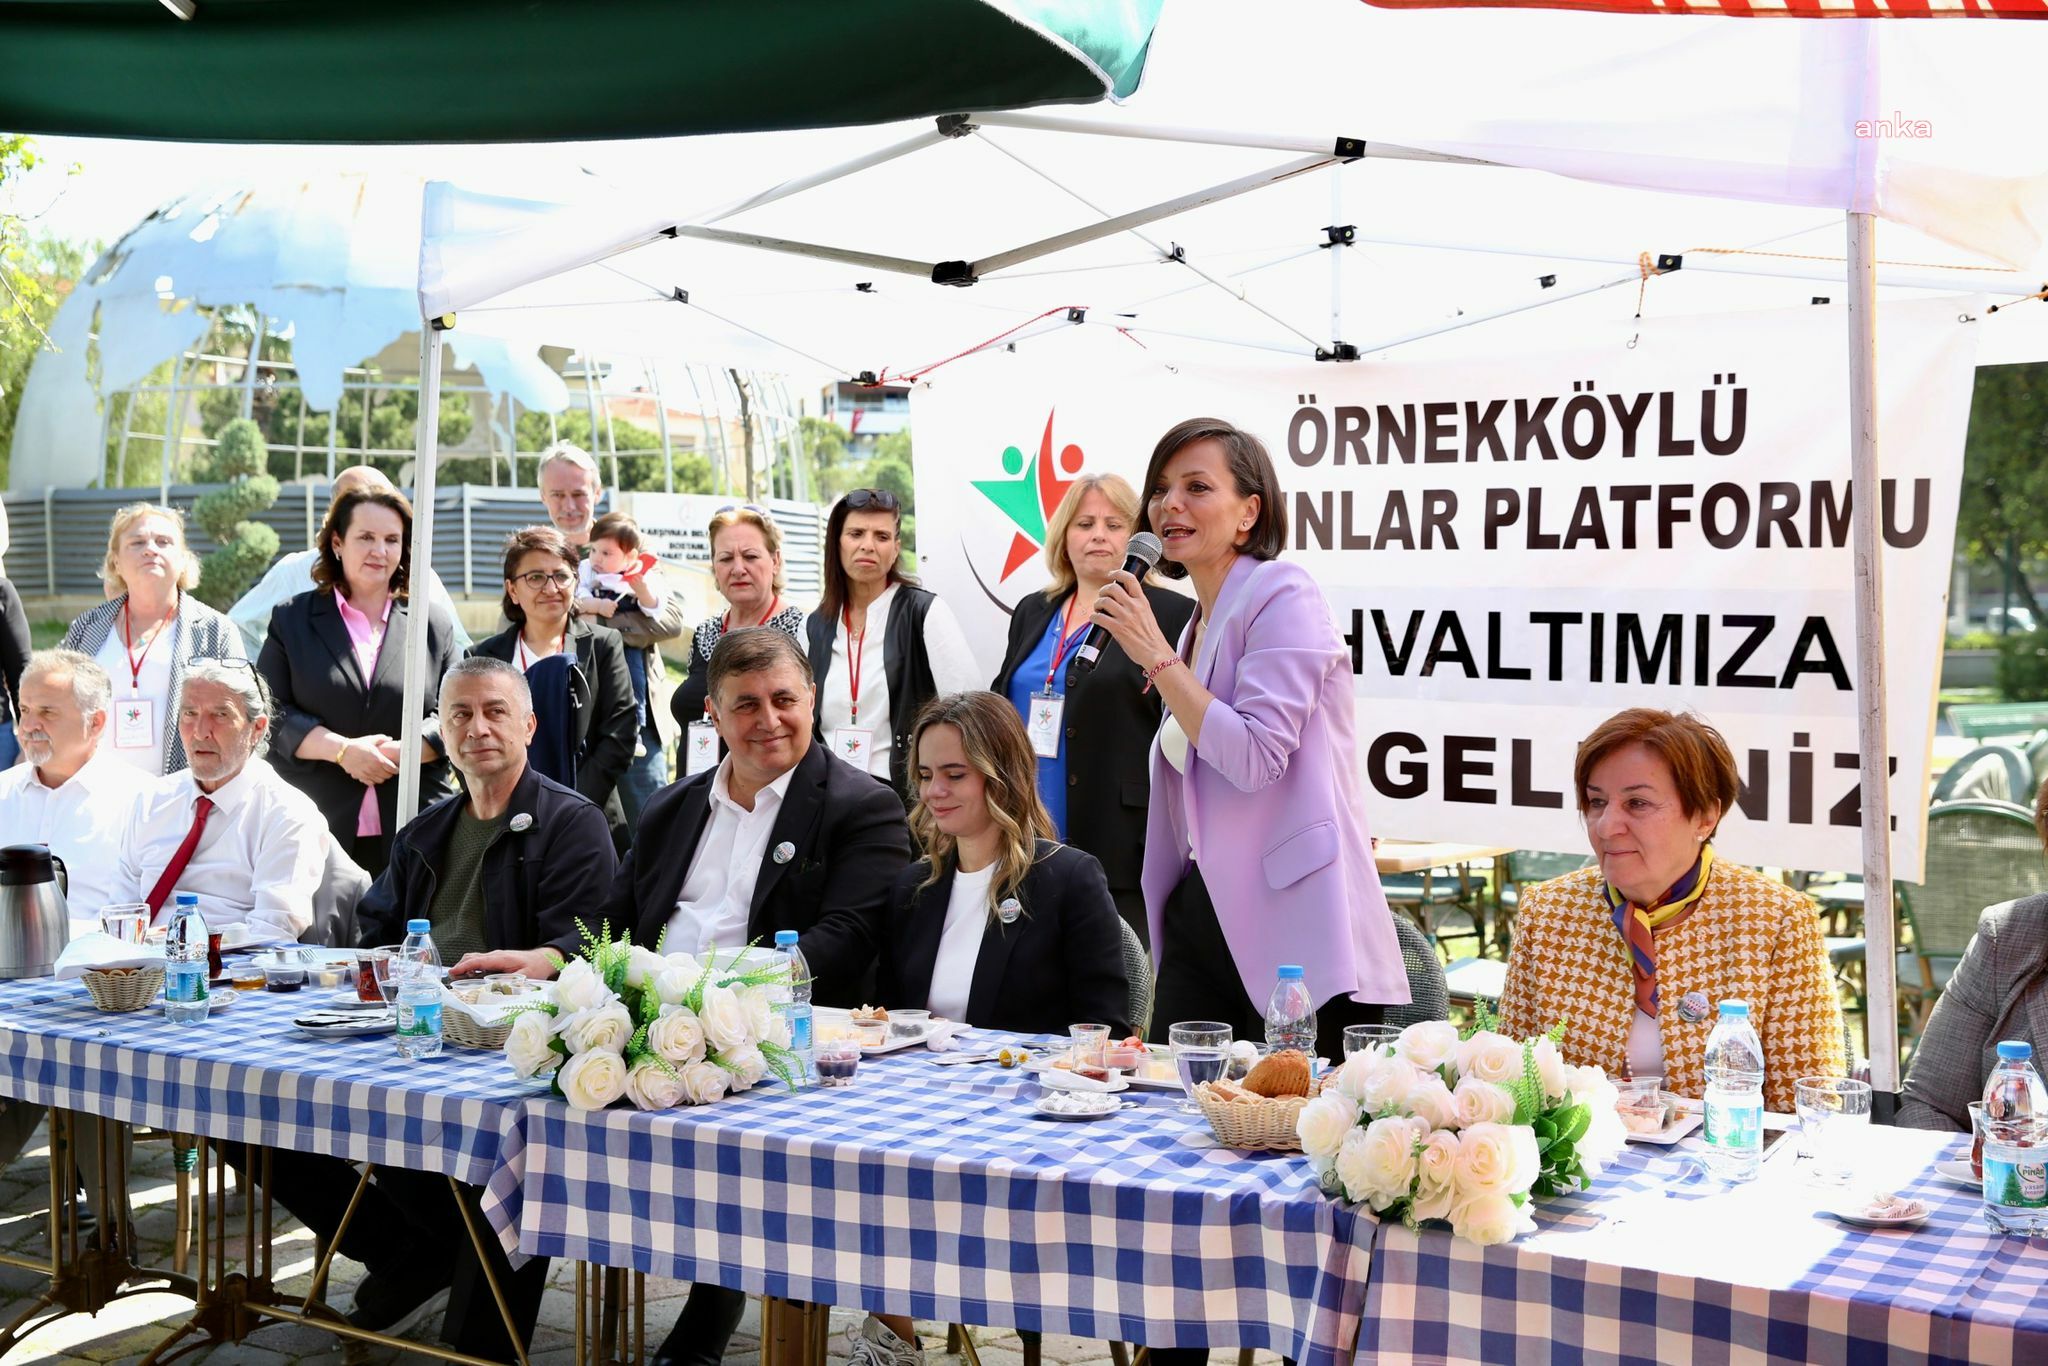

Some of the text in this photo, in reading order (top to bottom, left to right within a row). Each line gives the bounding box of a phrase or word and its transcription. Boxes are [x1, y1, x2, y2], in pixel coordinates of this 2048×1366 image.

[1288, 373, 1748, 467] ÖRNEKKÖYLÜ
[1282, 478, 1931, 551] NLAR PLATFORMU
[1367, 731, 1898, 832] GELNİZ
